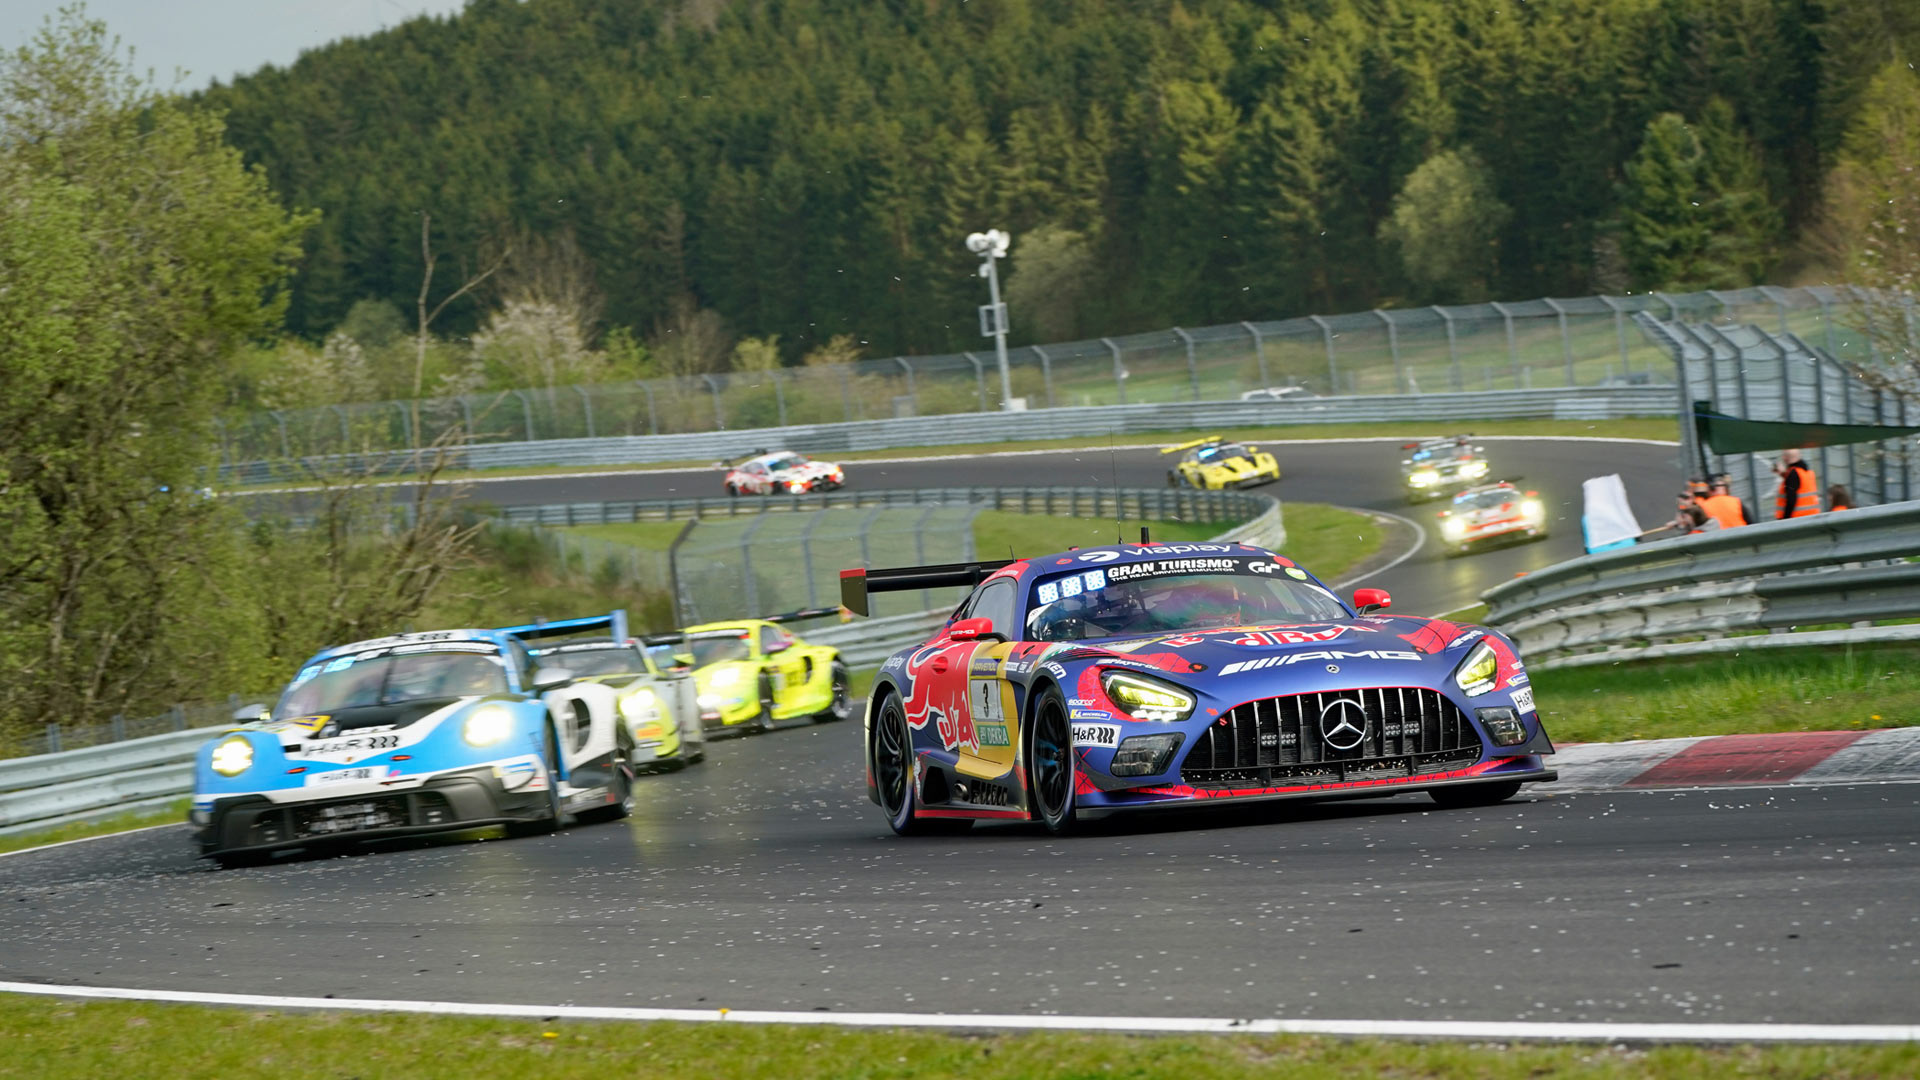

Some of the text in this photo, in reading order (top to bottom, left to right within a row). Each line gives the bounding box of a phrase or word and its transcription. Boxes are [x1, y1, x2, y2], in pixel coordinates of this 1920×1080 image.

[1107, 559, 1234, 578] GRAN TURISMO
[1129, 572, 1151, 580] REAL
[1152, 568, 1187, 576] DRIVING
[982, 682, 990, 718] 3
[987, 727, 1009, 745] DEKRA
[1072, 727, 1096, 741] H&R
